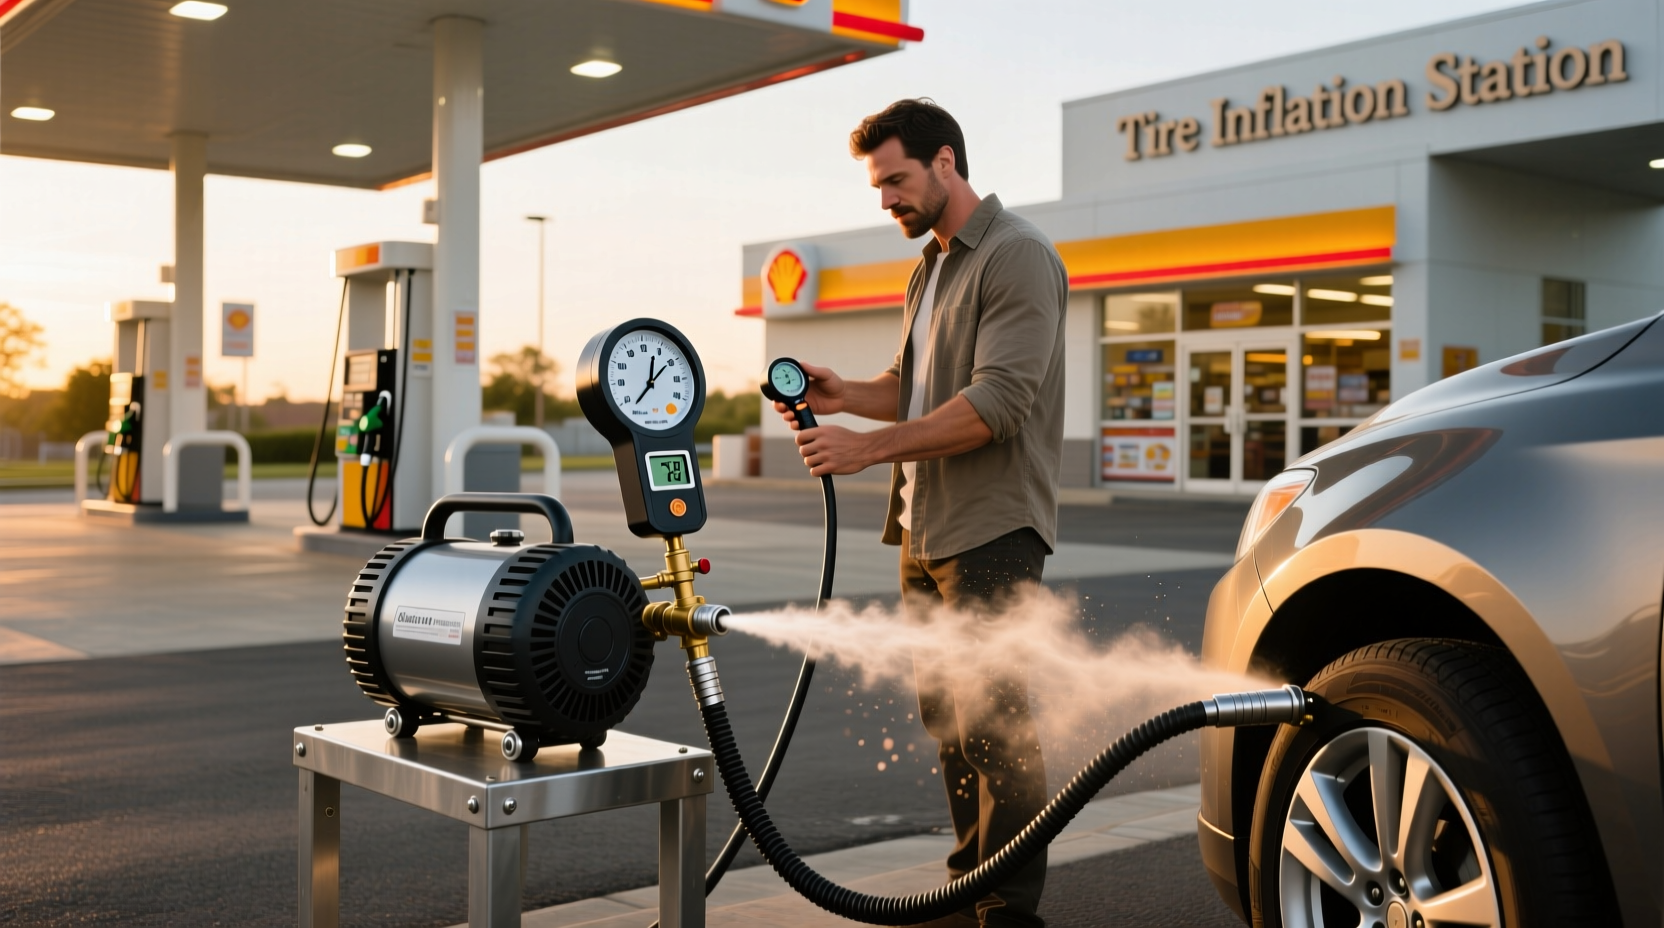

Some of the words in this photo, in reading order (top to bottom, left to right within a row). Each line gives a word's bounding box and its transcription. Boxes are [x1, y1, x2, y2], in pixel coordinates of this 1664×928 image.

[1117, 111, 1199, 161] Tire
[1210, 75, 1409, 148] Inflation
[1425, 36, 1628, 112] Station
